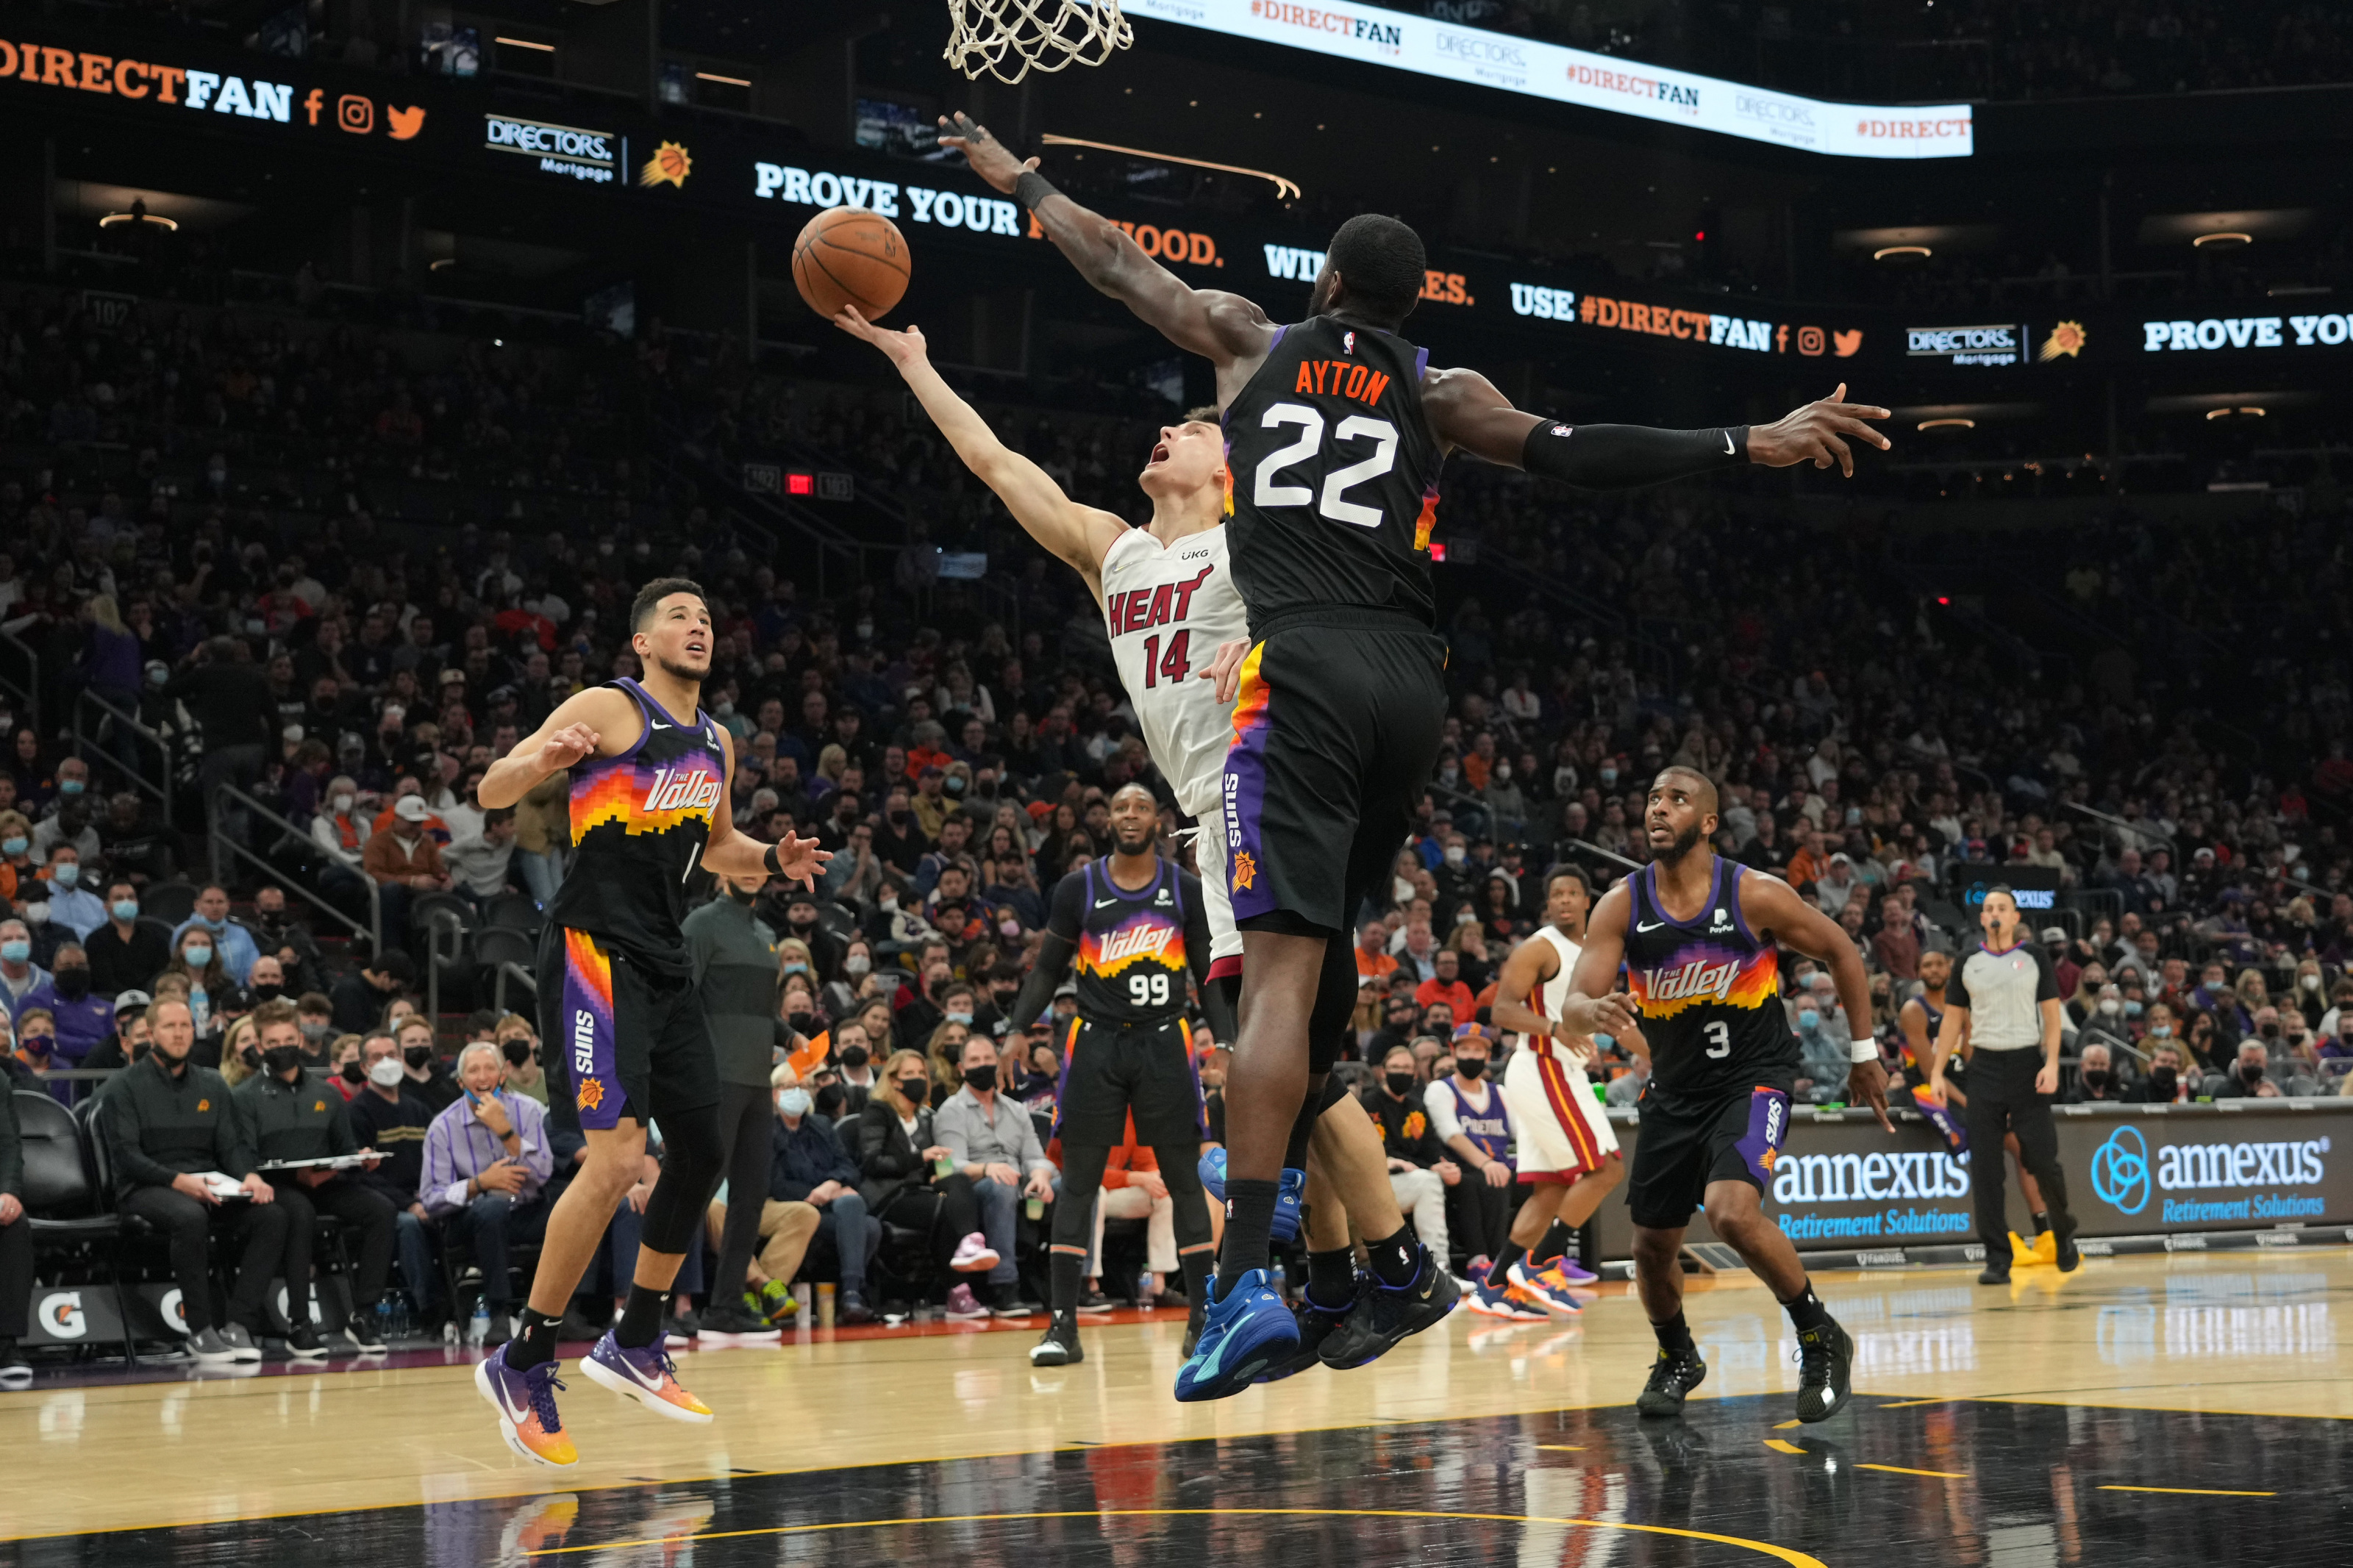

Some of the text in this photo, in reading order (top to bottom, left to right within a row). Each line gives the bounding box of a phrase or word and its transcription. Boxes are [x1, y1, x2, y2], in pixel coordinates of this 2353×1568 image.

[1251, 0, 1401, 46] #DIRECTFAN
[1566, 63, 1700, 107] #DIRECTFAN
[1857, 118, 1972, 140] #DIRECT
[540, 157, 613, 183] Mortgage
[754, 162, 899, 218] PROVE
[906, 186, 1021, 237] YOUR
[1510, 282, 1575, 323] USE
[1579, 294, 1772, 352] #DIRECTFAN
[2143, 314, 2353, 351] PROVE YO
[1952, 354, 2017, 366] Mortgage
[1295, 360, 1390, 407] AYTON
[1254, 402, 1399, 528] 22
[1182, 549, 1208, 560] UKG
[1108, 563, 1214, 640] HEAT
[1144, 629, 1190, 689] 14
[643, 768, 722, 820] Valley
[674, 773, 690, 781] THE
[1225, 773, 1241, 847] SUNS
[682, 842, 700, 884] 1
[1099, 923, 1175, 964] Valley
[1710, 924, 1734, 934] PayPal
[1129, 973, 1169, 1006] 99
[1643, 959, 1740, 1000] Valley
[1664, 968, 1682, 978] THE
[575, 1009, 593, 1074] SUNS
[1704, 1020, 1731, 1059] 3
[1779, 1208, 1970, 1239] Retirement Solutions
[2162, 1193, 2324, 1223] Retirement Solutions
[39, 1292, 87, 1339] G
